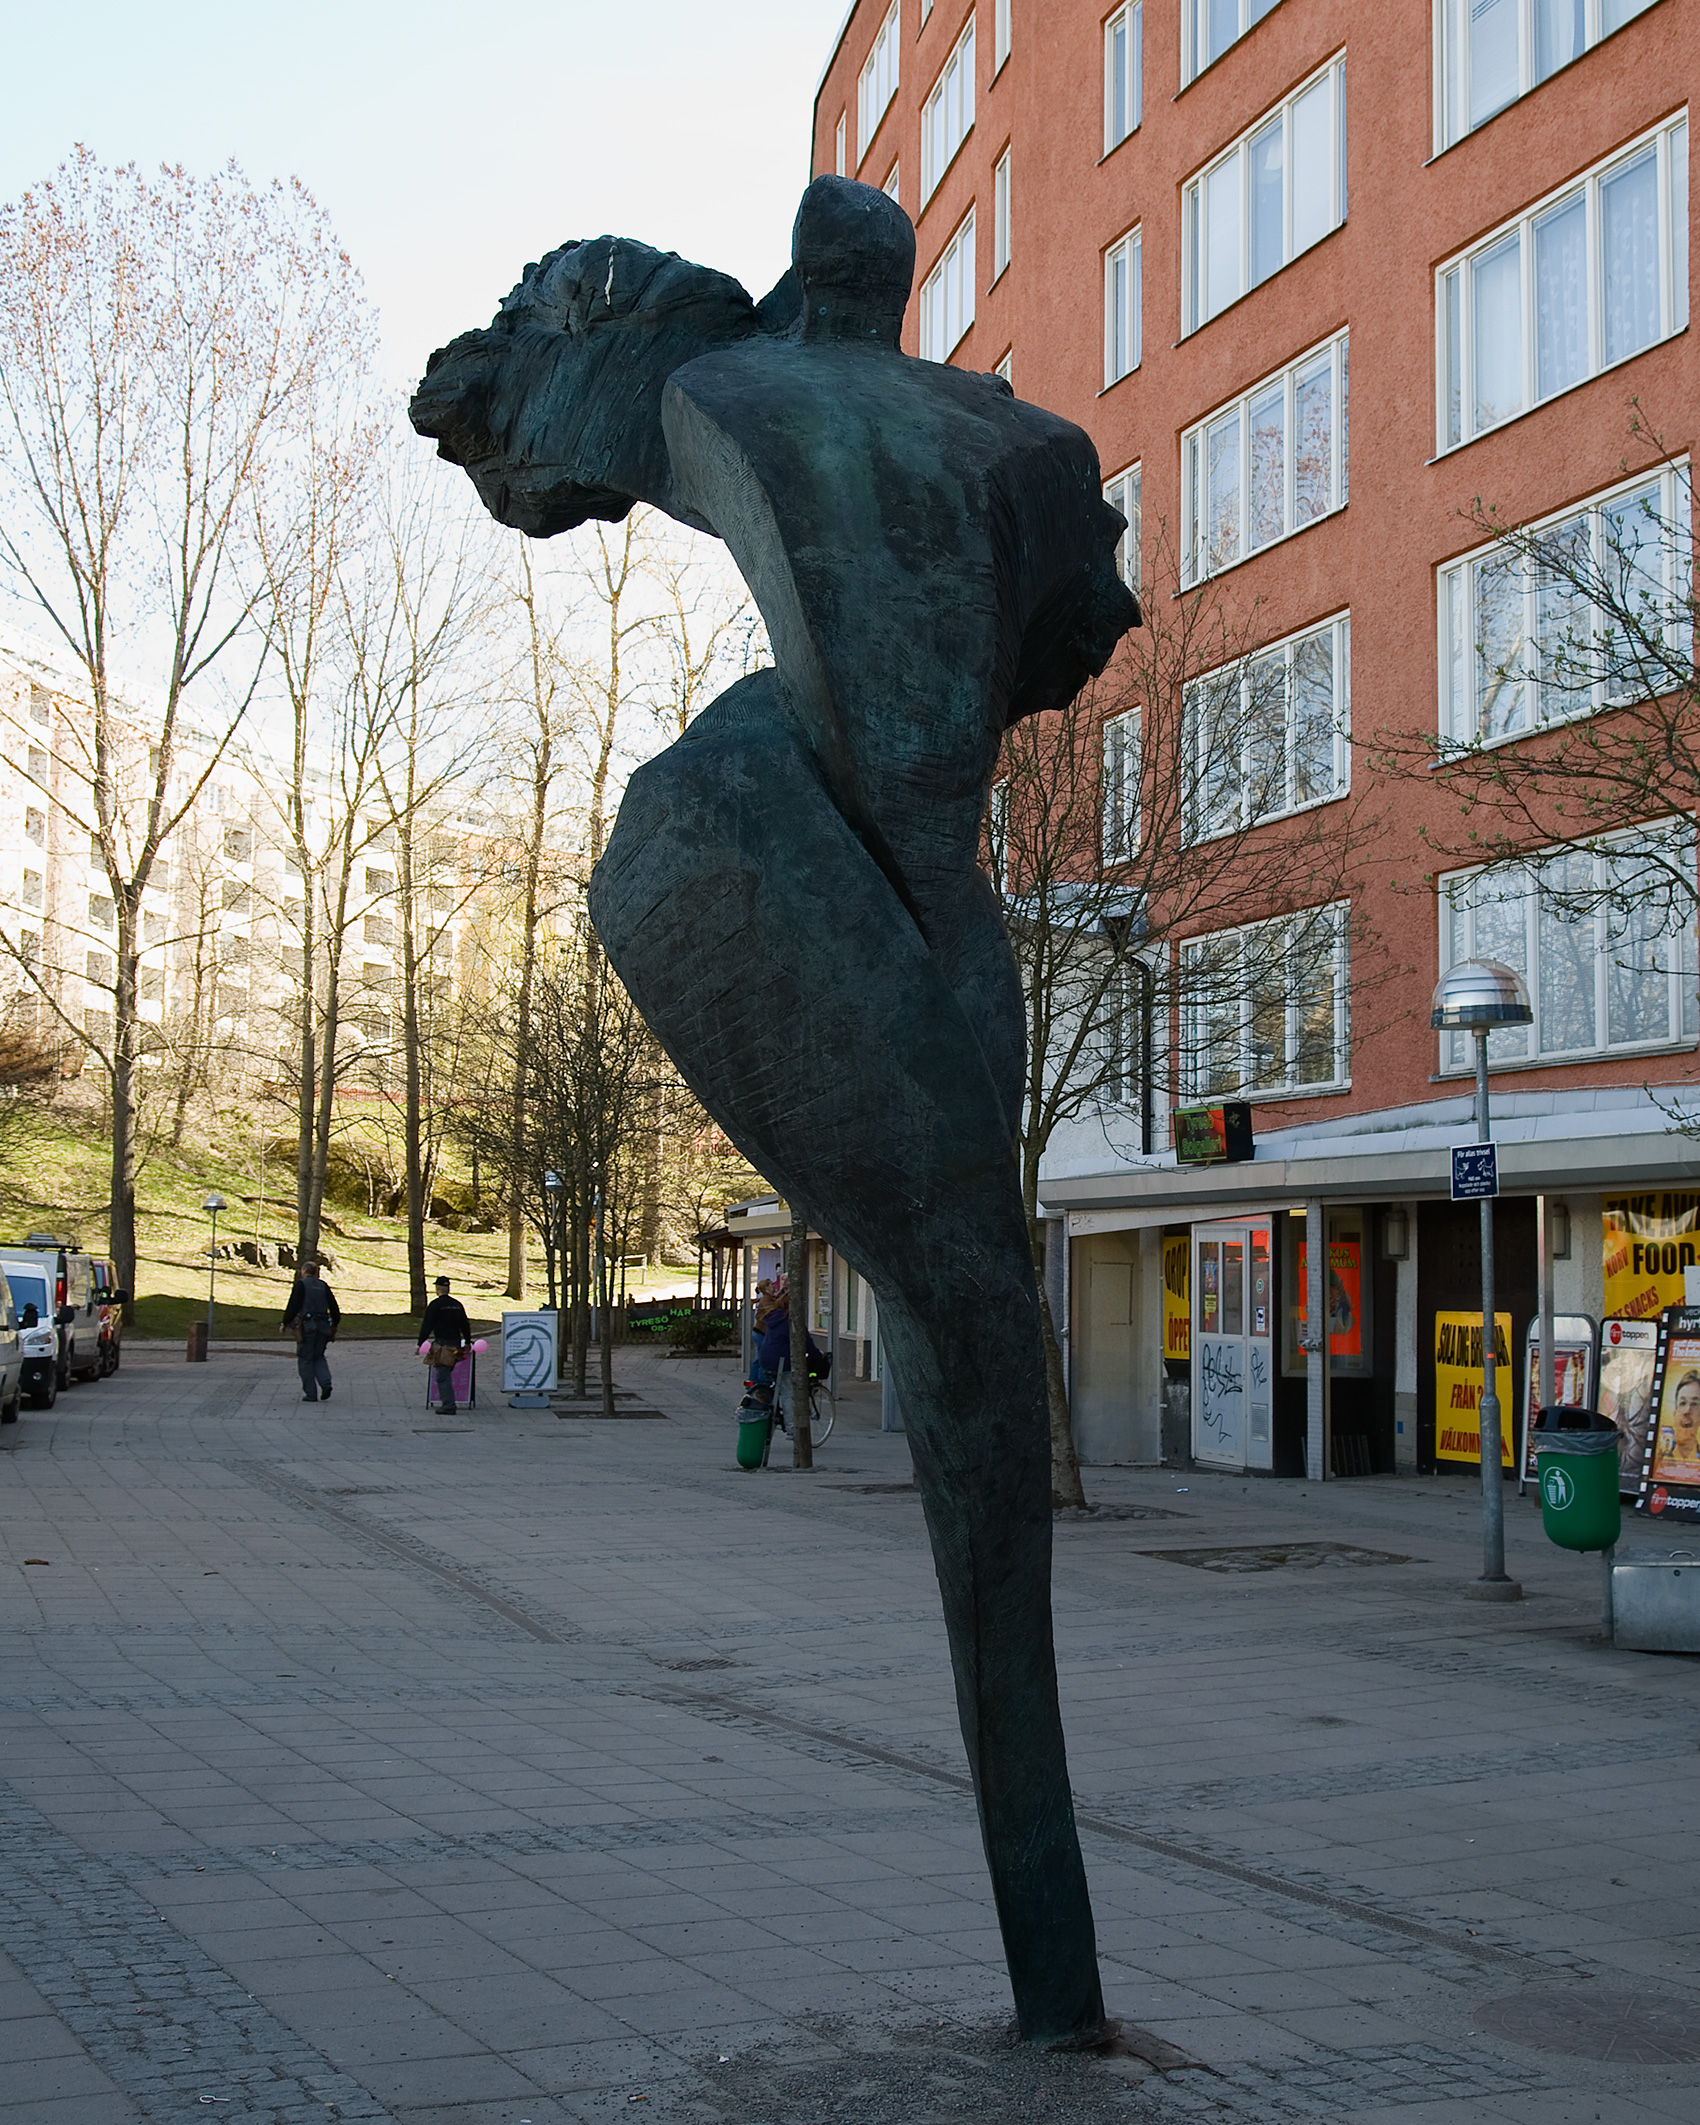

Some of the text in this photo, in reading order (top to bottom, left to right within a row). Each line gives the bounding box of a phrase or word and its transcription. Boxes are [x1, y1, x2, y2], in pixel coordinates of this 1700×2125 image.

[1607, 1194, 1656, 1237] TAKE
[1301, 1257, 1357, 1268] MMUM
[1605, 1246, 1629, 1278] KORV
[1633, 1242, 1696, 1275] FOOD
[1623, 1285, 1660, 1318] SNACKS
[629, 1315, 669, 1328] TYRESÖ
[1168, 1311, 1190, 1352] ÖPPE
[1450, 1378, 1476, 1410] FRÅN
[1440, 1427, 1510, 1457] VÄLKOMN
